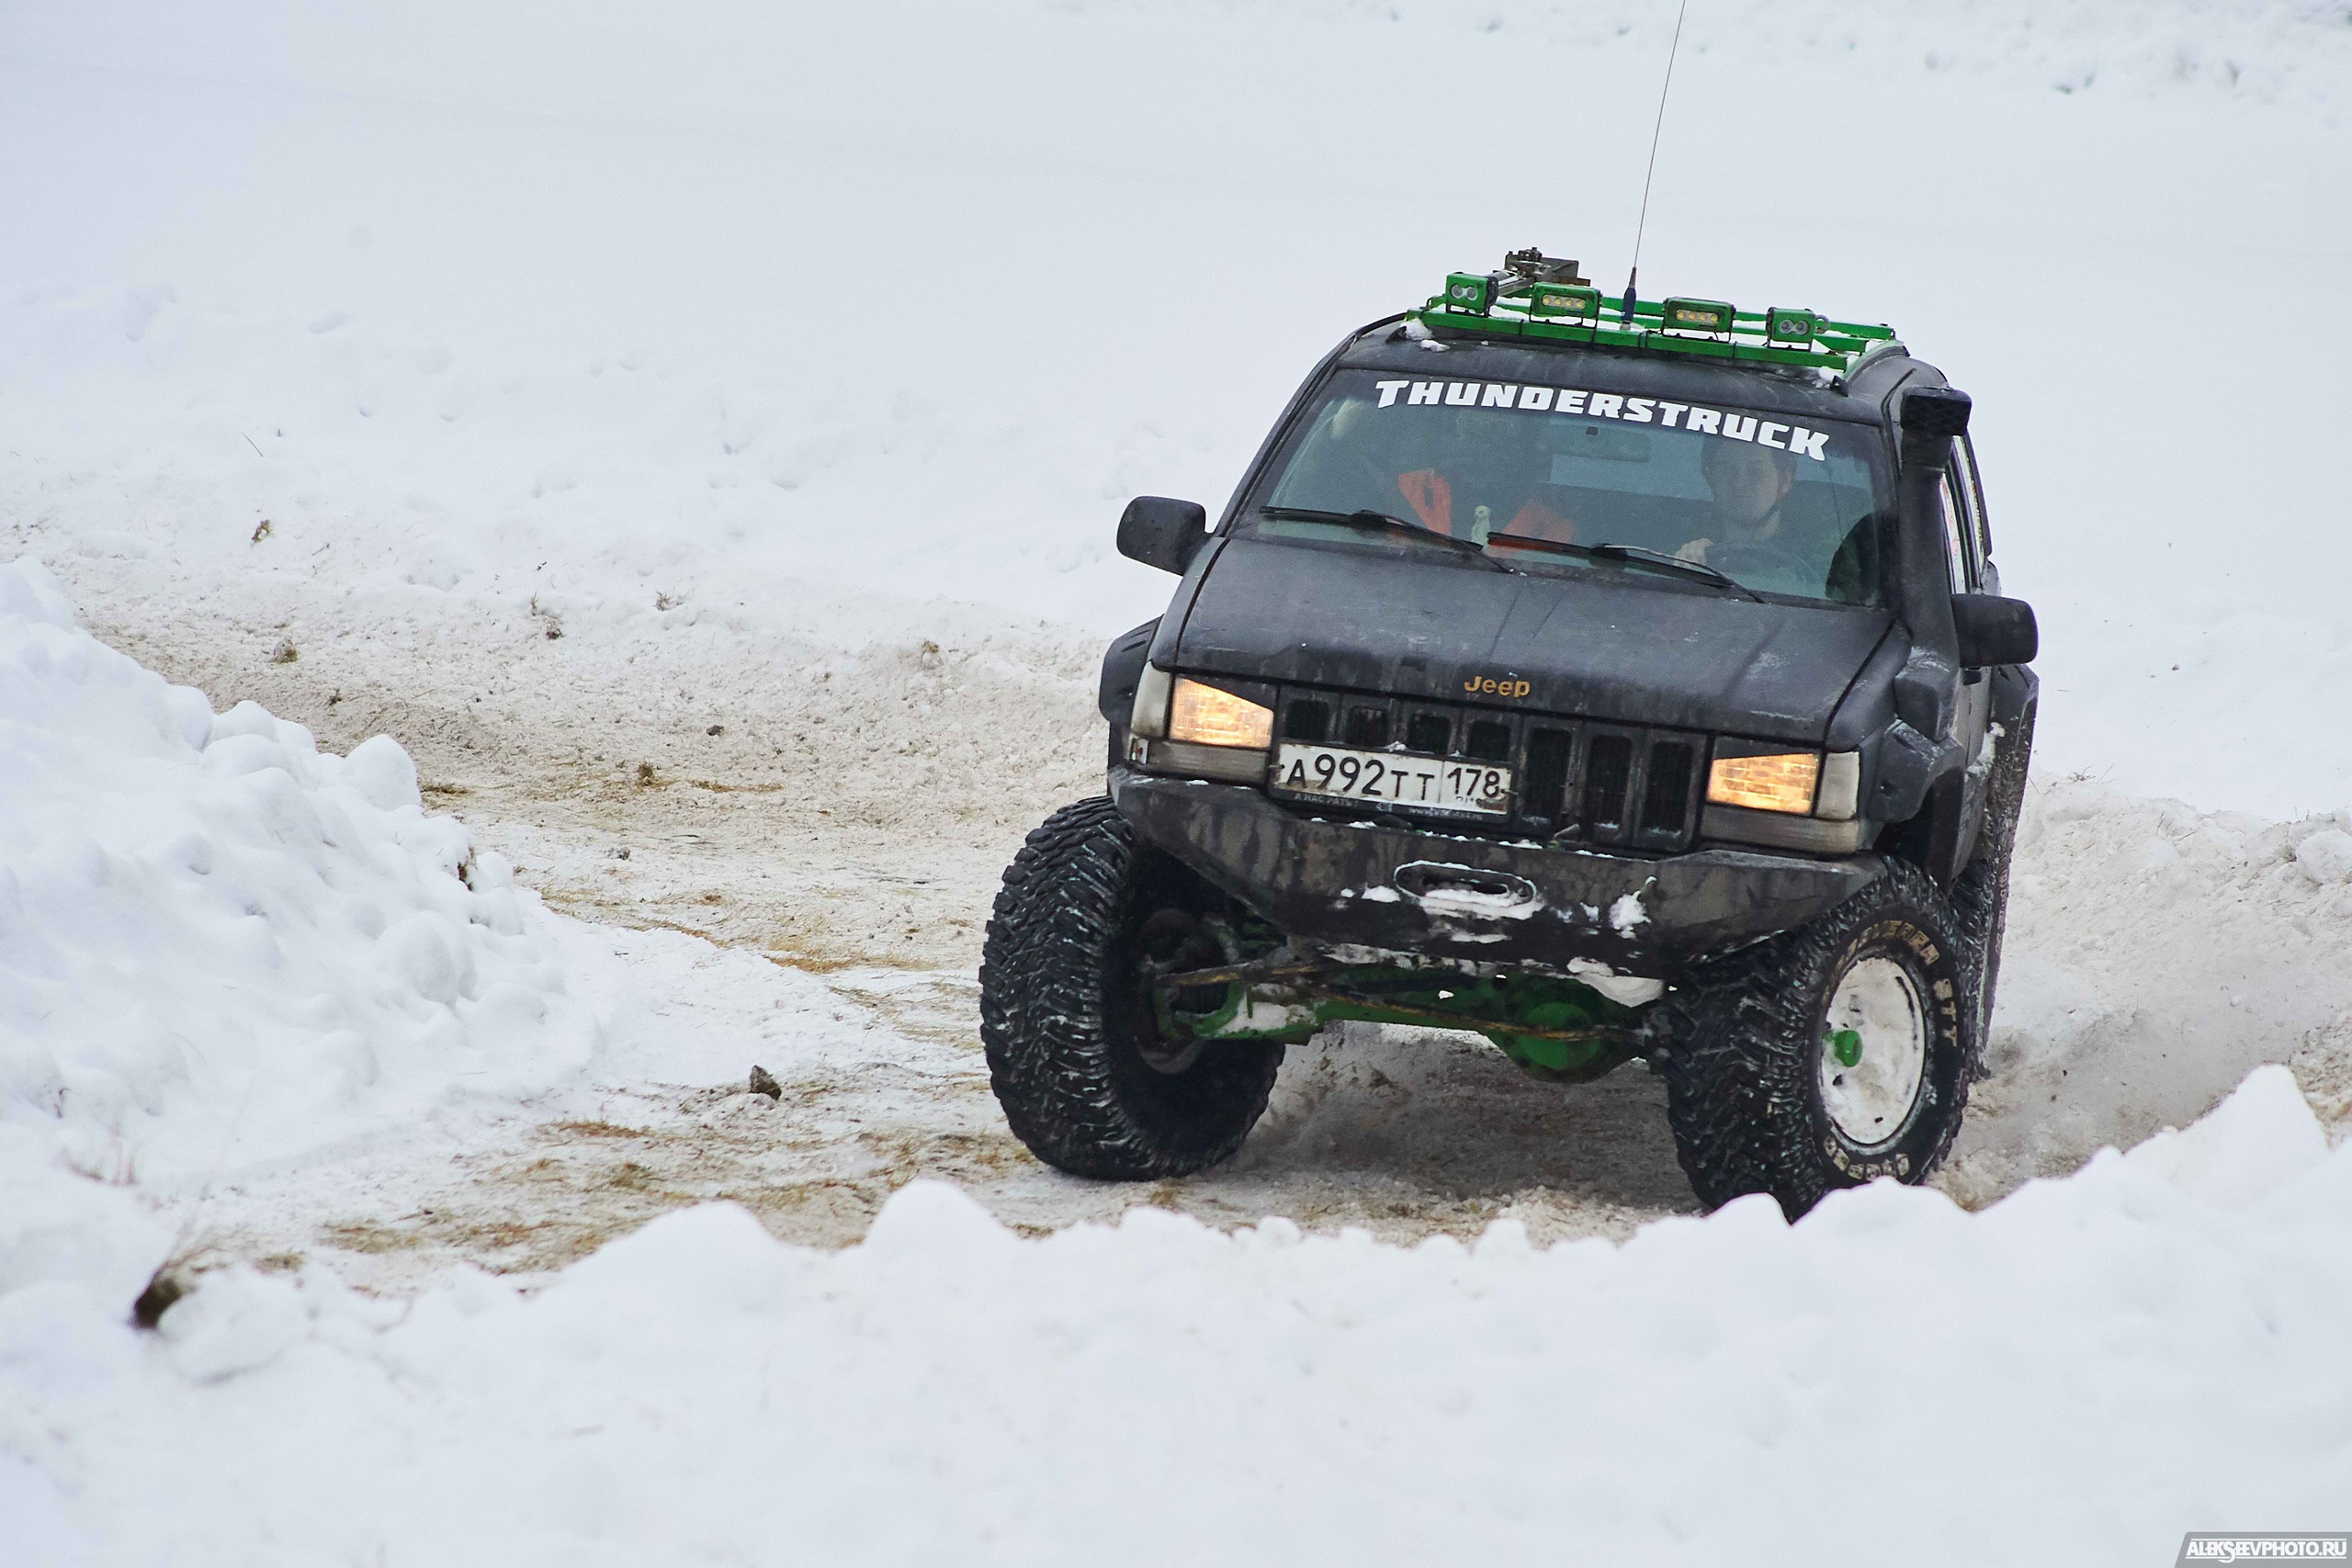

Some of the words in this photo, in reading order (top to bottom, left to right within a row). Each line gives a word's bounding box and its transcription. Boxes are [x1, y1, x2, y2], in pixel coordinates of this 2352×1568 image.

[1375, 380, 1829, 461] THUNDERSTRUCK
[1464, 675, 1531, 698] Jeep
[1447, 768, 1500, 798] 178
